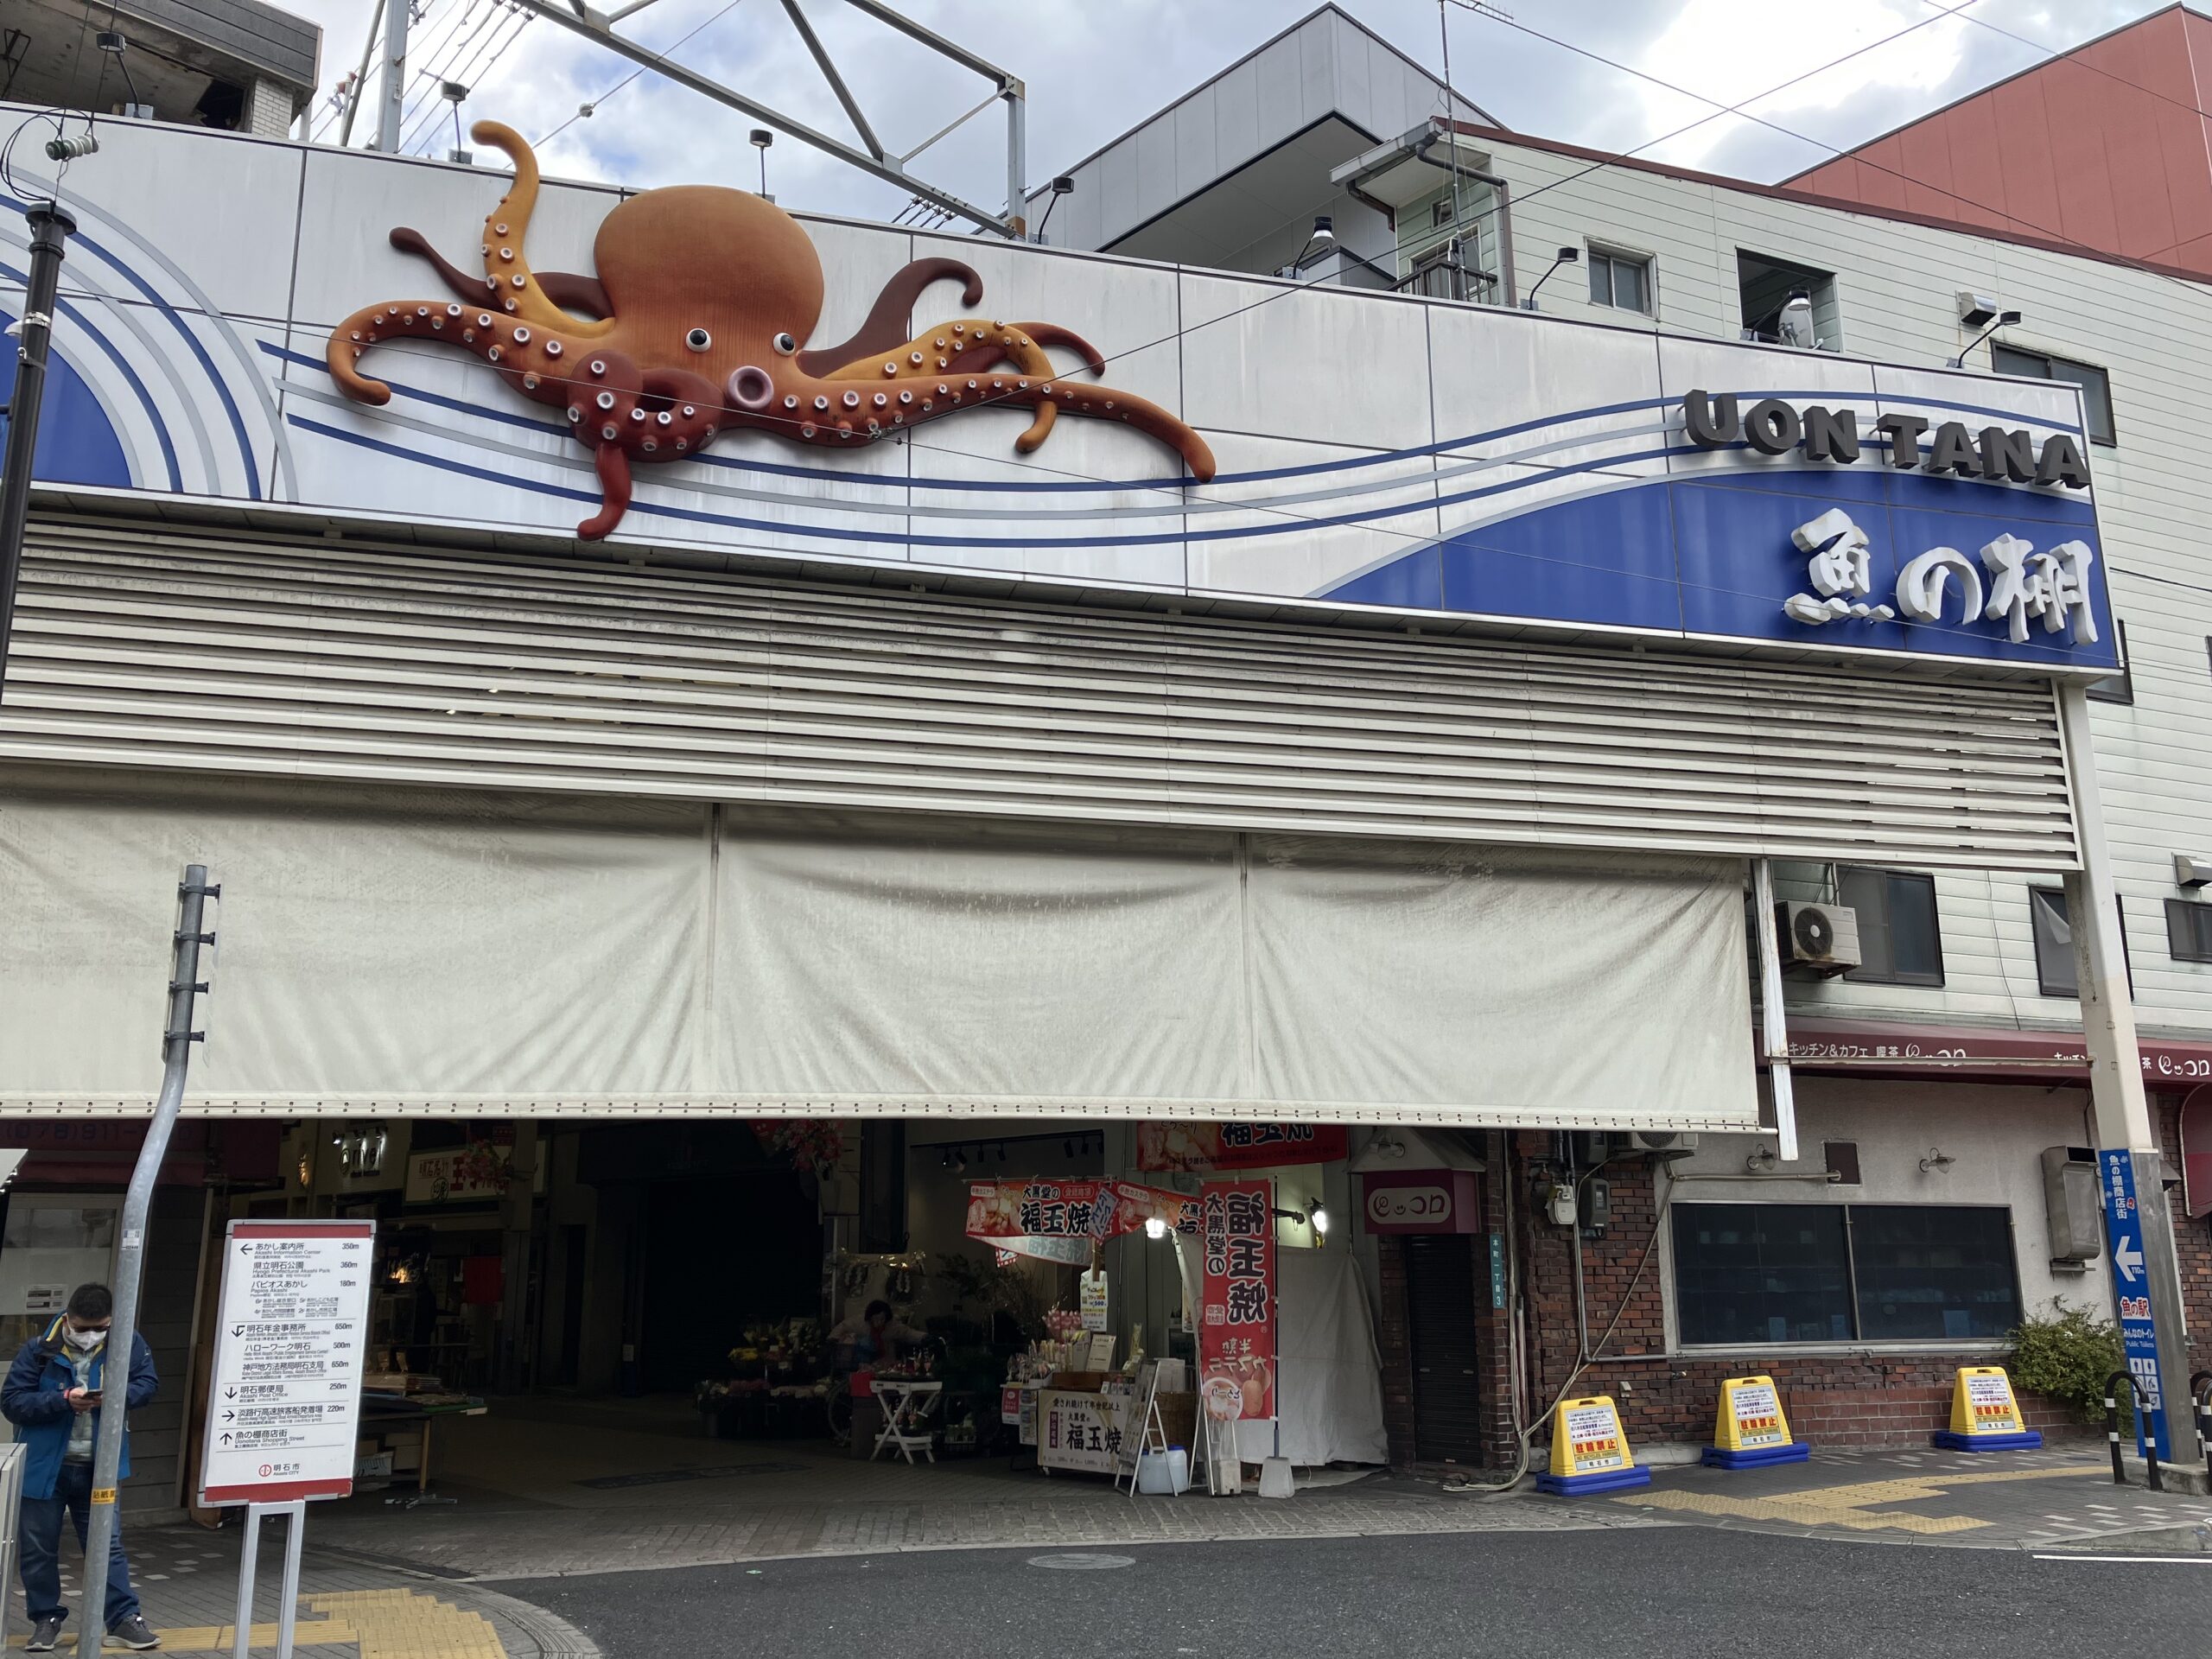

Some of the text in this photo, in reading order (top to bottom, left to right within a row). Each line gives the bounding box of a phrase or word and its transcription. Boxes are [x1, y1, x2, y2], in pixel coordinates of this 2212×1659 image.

[1784, 507, 2100, 645] 魚の棚
[1876, 1046, 1898, 1058] 喫茶
[1022, 1185, 1059, 1199] 大黒堂の
[2108, 1154, 2128, 1220] 魚の棚商店街
[1020, 1203, 1091, 1234] 福玉焼
[255, 1243, 305, 1251] あかし案内所
[253, 1261, 304, 1269] 県立明石公園
[2131, 1266, 2145, 1274] 110m
[1492, 1239, 1502, 1306] 本町一丁目3
[2121, 1298, 2151, 1317] 魚の駅
[246, 1323, 307, 1333] 明石年金事務所
[245, 1342, 311, 1351] ハローワーク明石
[242, 1361, 324, 1370] 神戸地方法務局明石支局
[240, 1384, 284, 1394] 明石郵便局
[238, 1405, 323, 1417] 淡路行高速旅客船発着場
[1740, 1417, 1777, 1429] 駐輪禁止
[235, 1428, 288, 1439] 魚の棚商店街
[1065, 1422, 1122, 1454] 福玉焼
[1575, 1439, 1616, 1453] 駐輪禁止
[273, 1463, 301, 1471] 明石市
